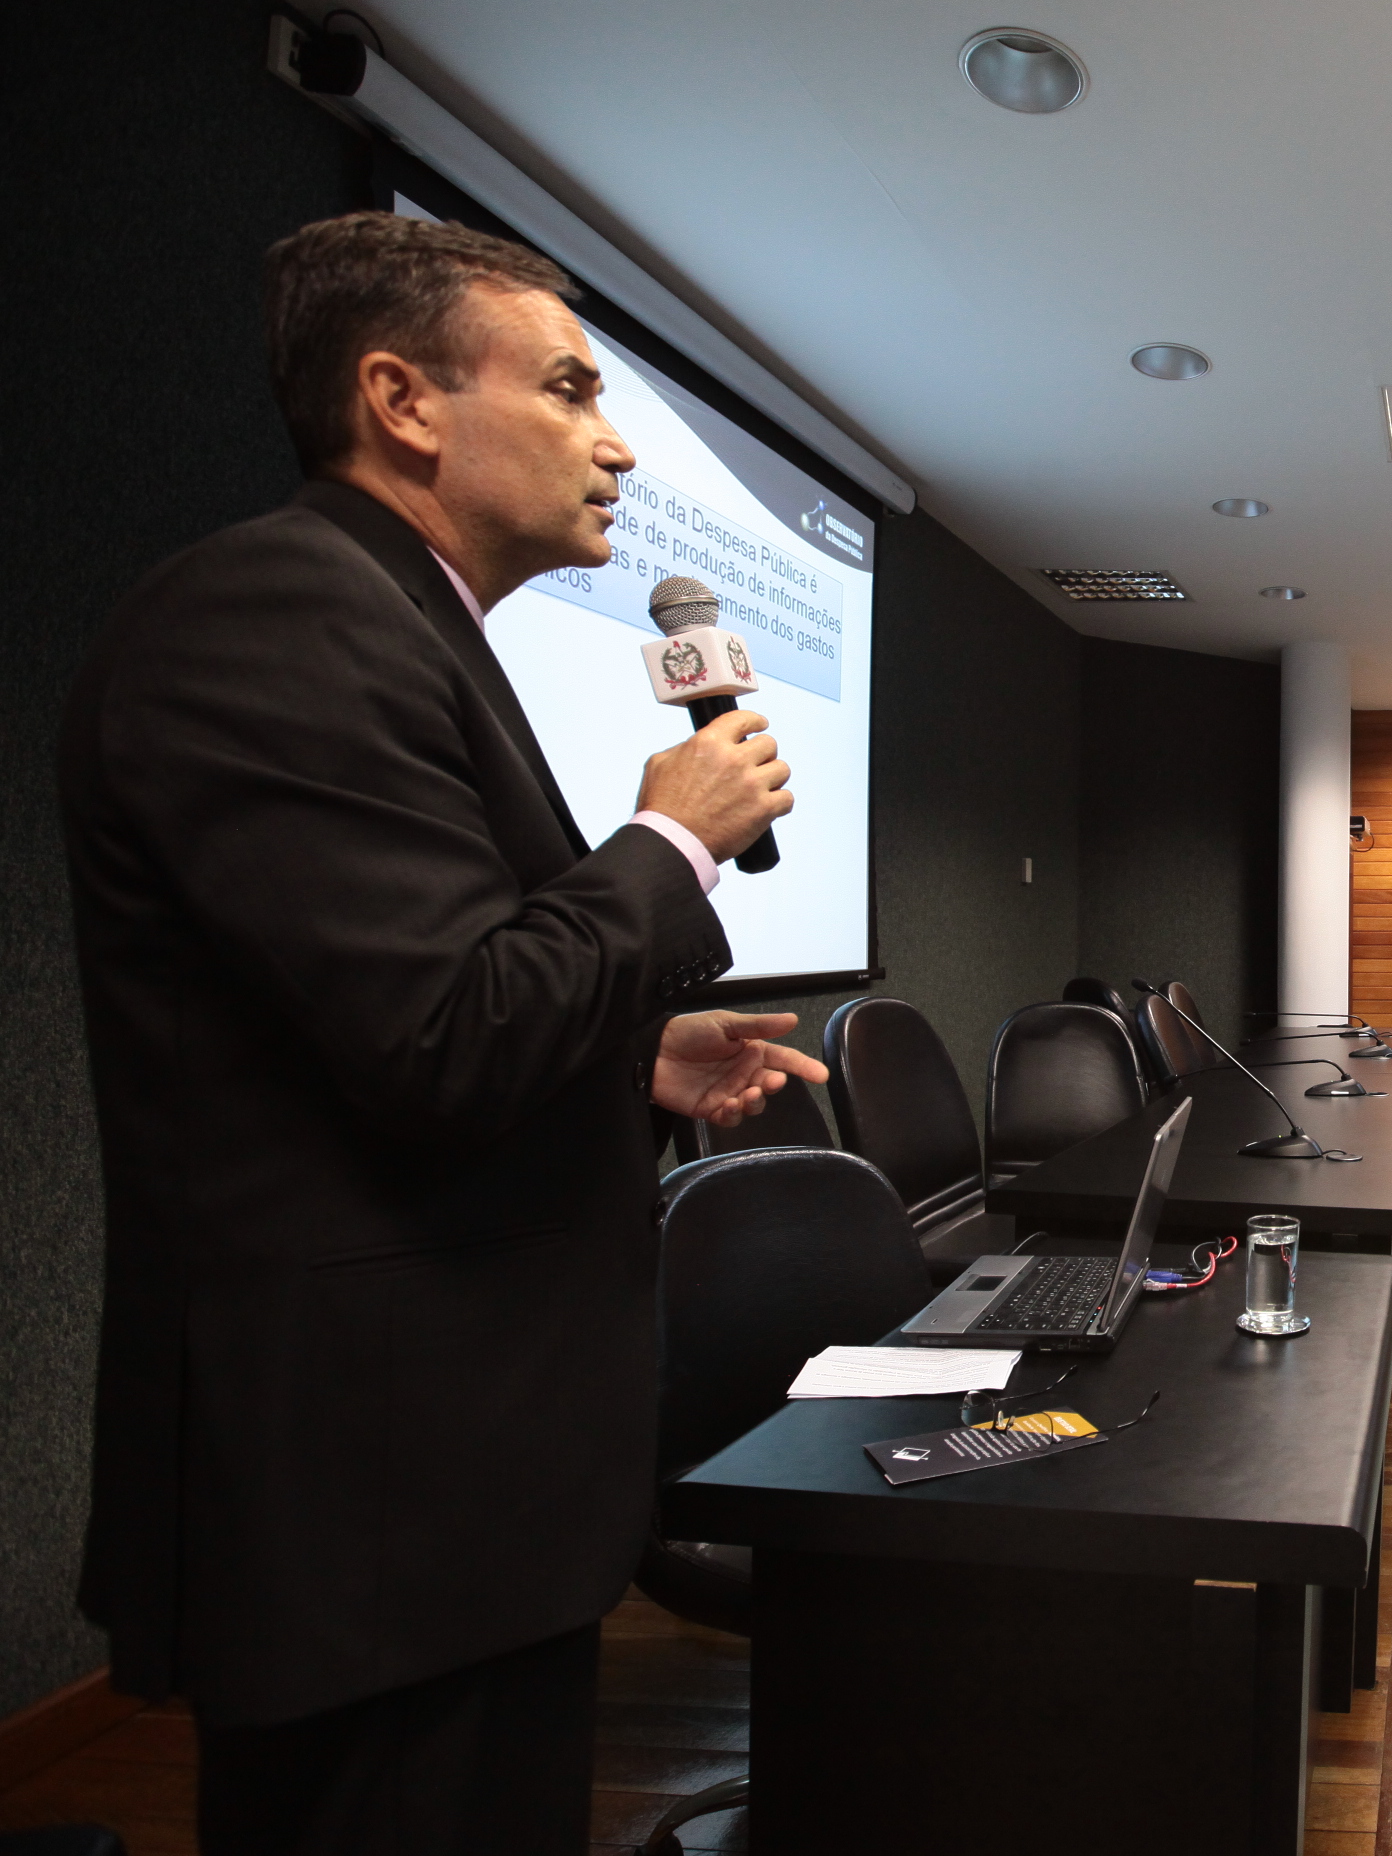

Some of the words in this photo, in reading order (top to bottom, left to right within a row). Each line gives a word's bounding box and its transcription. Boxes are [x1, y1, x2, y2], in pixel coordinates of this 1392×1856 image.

[645, 520, 667, 550] de
[673, 536, 745, 588] produção
[748, 571, 766, 598] de
[768, 579, 842, 635] informações
[666, 495, 686, 525] da
[692, 507, 757, 563] Despesa
[761, 545, 807, 588] Pública
[810, 574, 818, 595] é
[636, 557, 648, 578] e
[770, 614, 794, 642] dos
[796, 630, 836, 660] gastos
